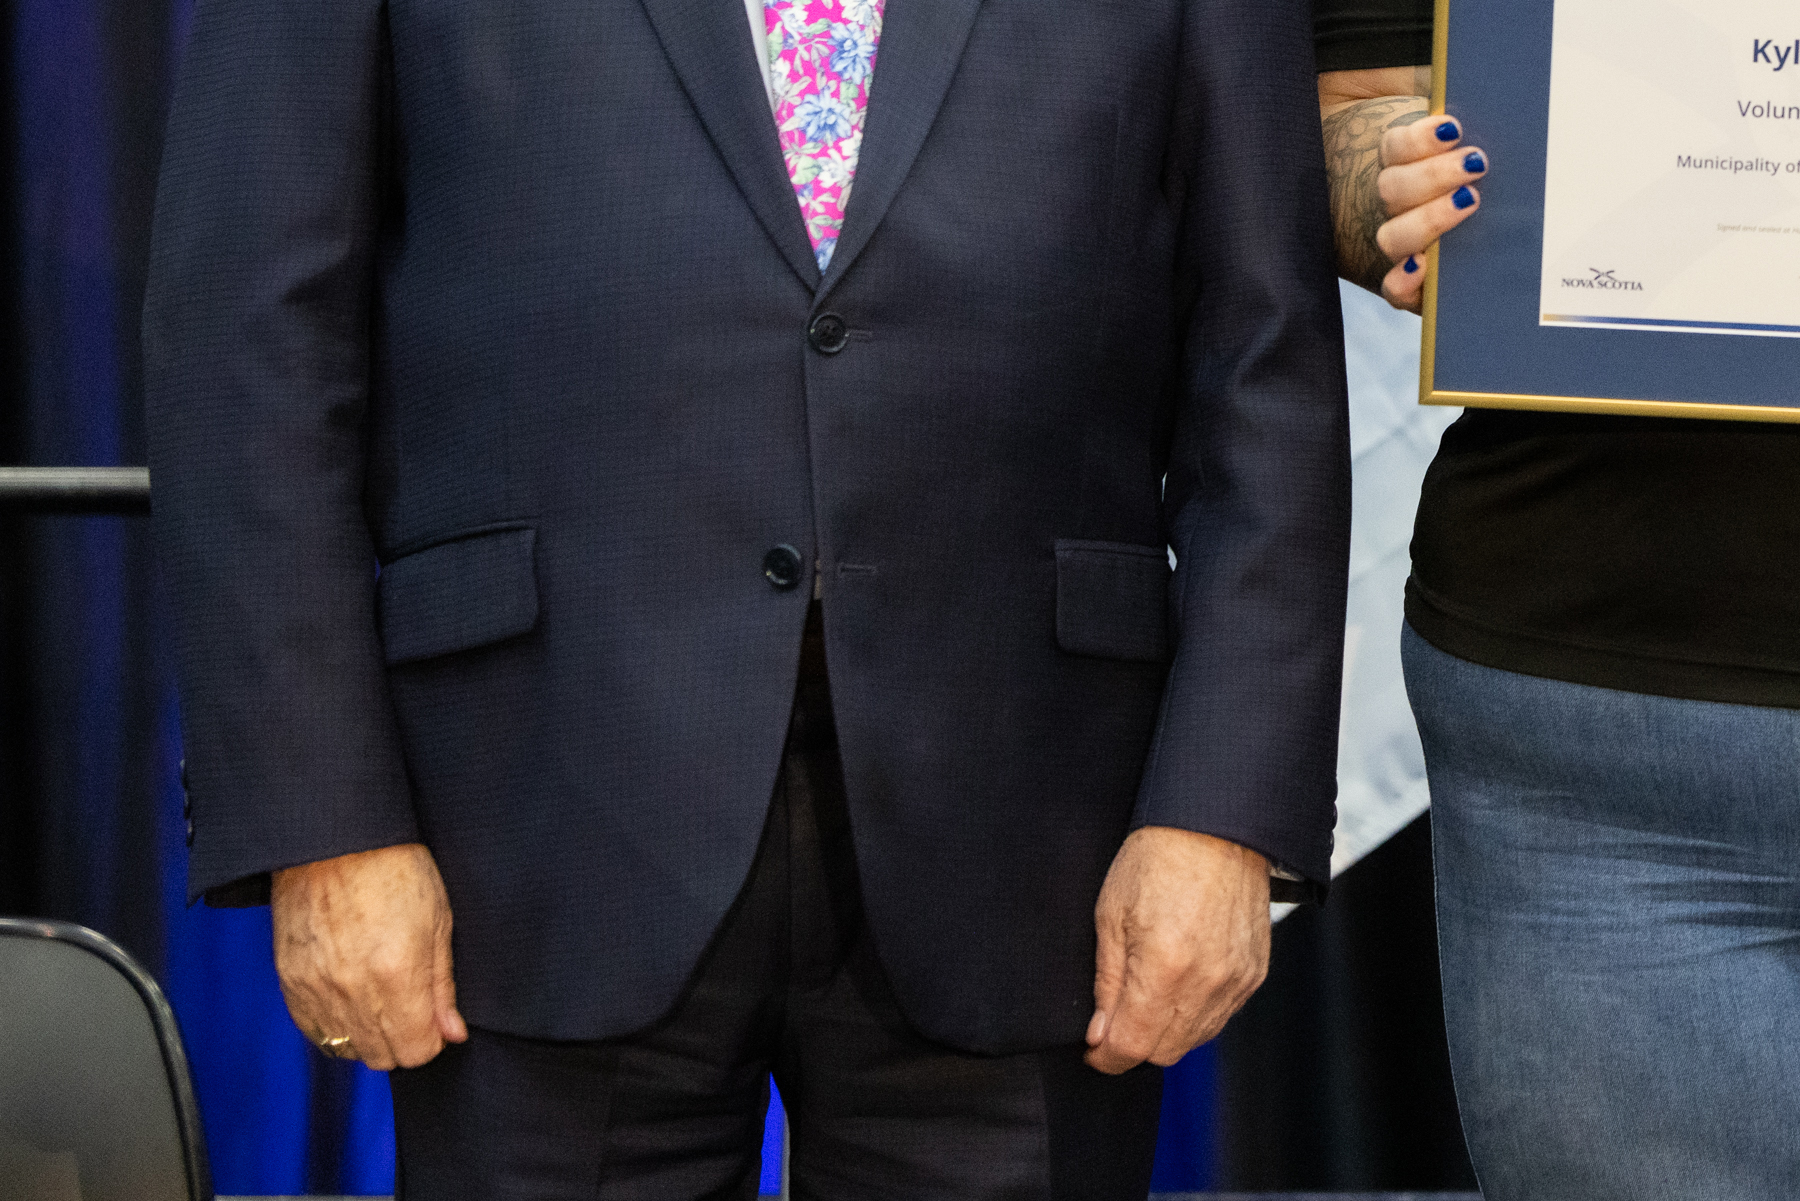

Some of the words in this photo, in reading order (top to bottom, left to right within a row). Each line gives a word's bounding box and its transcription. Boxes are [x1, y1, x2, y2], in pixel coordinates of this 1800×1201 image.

[1676, 155, 1780, 175] Municipality
[1561, 278, 1594, 288] NOVA
[1597, 280, 1643, 291] SCOTIA
